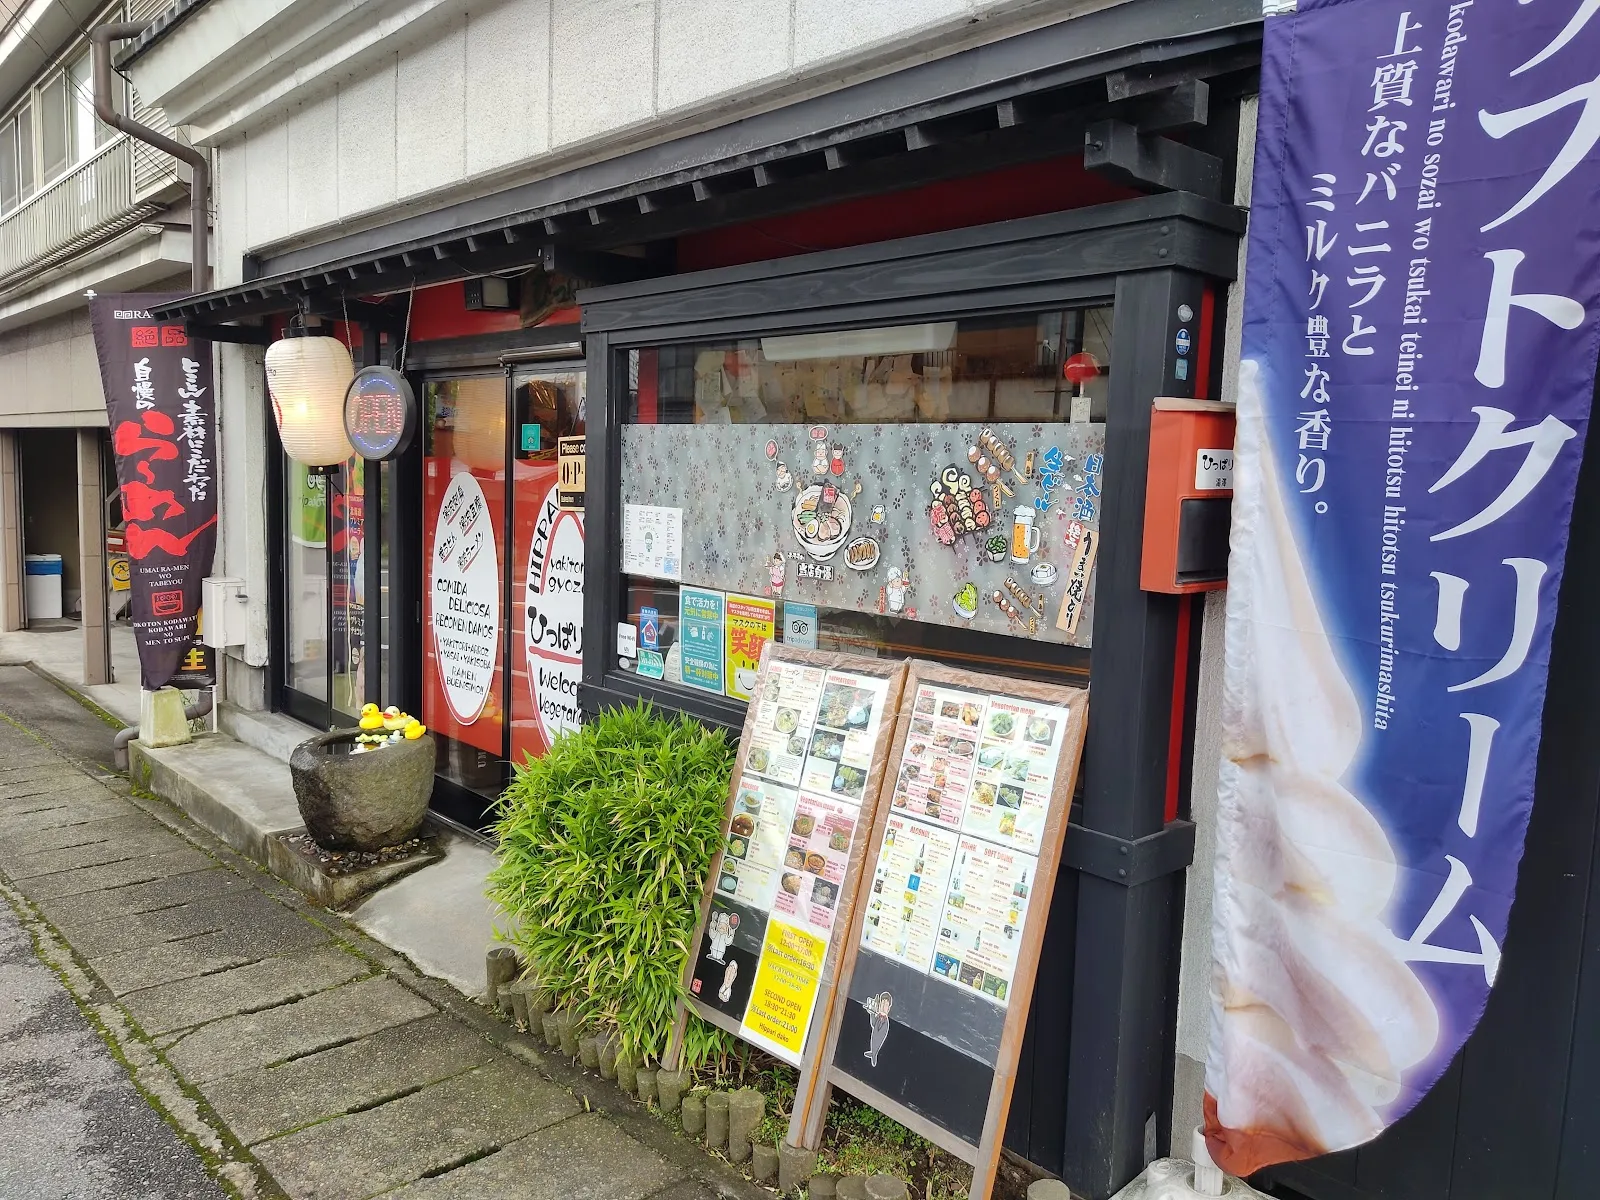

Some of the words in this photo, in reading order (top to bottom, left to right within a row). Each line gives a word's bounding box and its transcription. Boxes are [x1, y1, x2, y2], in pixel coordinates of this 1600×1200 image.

[1432, 0, 1474, 113] kodawari
[1425, 118, 1447, 147] no
[1341, 11, 1423, 356] 上質なバニラと
[1416, 152, 1442, 211] sozai
[1411, 216, 1433, 252] wo
[1402, 256, 1432, 325] tsukai
[1294, 173, 1338, 514] ミルク豊な香り。
[1394, 332, 1424, 392] teinei
[131, 357, 156, 410] 自慢の
[1391, 398, 1416, 419] ni
[561, 442, 579, 455] Please
[1202, 454, 1233, 471] ひっぱり
[1385, 426, 1413, 498] hitotsu
[528, 488, 560, 594] HIPPA
[1382, 504, 1407, 576] hitotsu
[139, 567, 159, 575] UMAI
[161, 564, 190, 573] RA-MEN
[149, 578, 184, 588] TABEYOU
[436, 577, 468, 597] COMIDA
[549, 576, 584, 594] gyoz
[448, 596, 491, 619] DELICIOSA
[148, 624, 187, 633] KODAWARI
[527, 605, 583, 655] ひっぱり
[732, 618, 767, 631] マスクの下は
[145, 638, 161, 646] MEN
[163, 637, 173, 645] TO
[181, 647, 207, 671] 生
[1374, 582, 1400, 731] tsukurimashita
[451, 665, 477, 682] RAMEN
[798, 936, 814, 948] OPEN
[764, 988, 786, 1005] SECOND
[786, 998, 802, 1013] OPEN
[758, 1022, 777, 1038] Hippari
[776, 1030, 789, 1044] dako
